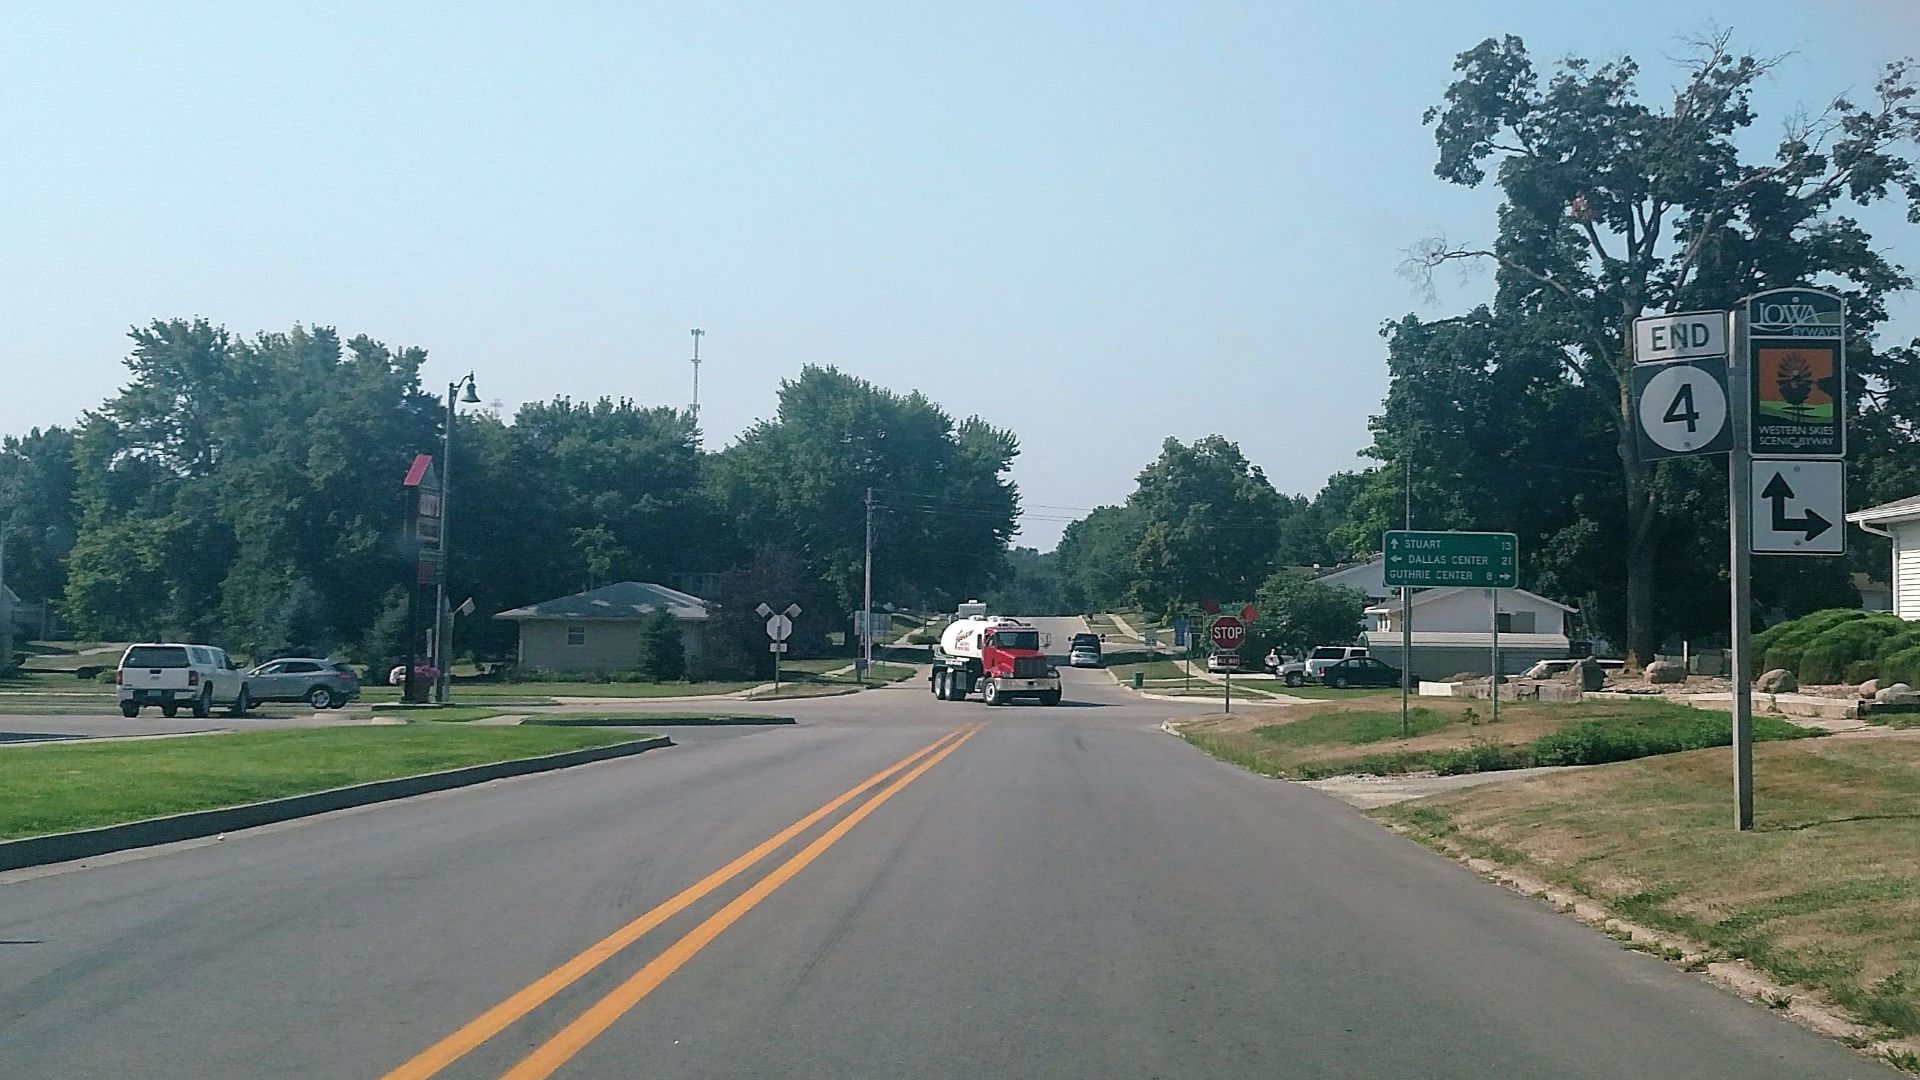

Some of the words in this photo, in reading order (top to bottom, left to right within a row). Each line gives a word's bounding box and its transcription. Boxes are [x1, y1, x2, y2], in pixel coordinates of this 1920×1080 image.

[1759, 303, 1821, 325] IOWA
[1651, 323, 1709, 351] END
[1792, 327, 1839, 337] BYWAYS
[1663, 383, 1699, 432] 4
[1758, 425, 1806, 435] WESTERN
[1808, 426, 1834, 435] SKIES
[1759, 436, 1796, 446] SCENIC
[1799, 437, 1834, 446] BYWAY
[1404, 539, 1441, 549] STUART
[1501, 541, 1512, 551] 13
[1408, 554, 1446, 564] DALLAS
[1451, 555, 1488, 565] CENTER
[1501, 556, 1512, 566] 21
[1389, 569, 1431, 579] GUTHRIE
[1436, 570, 1473, 580] CENTER
[1486, 571, 1493, 581] 8
[1214, 627, 1242, 639] STOP
